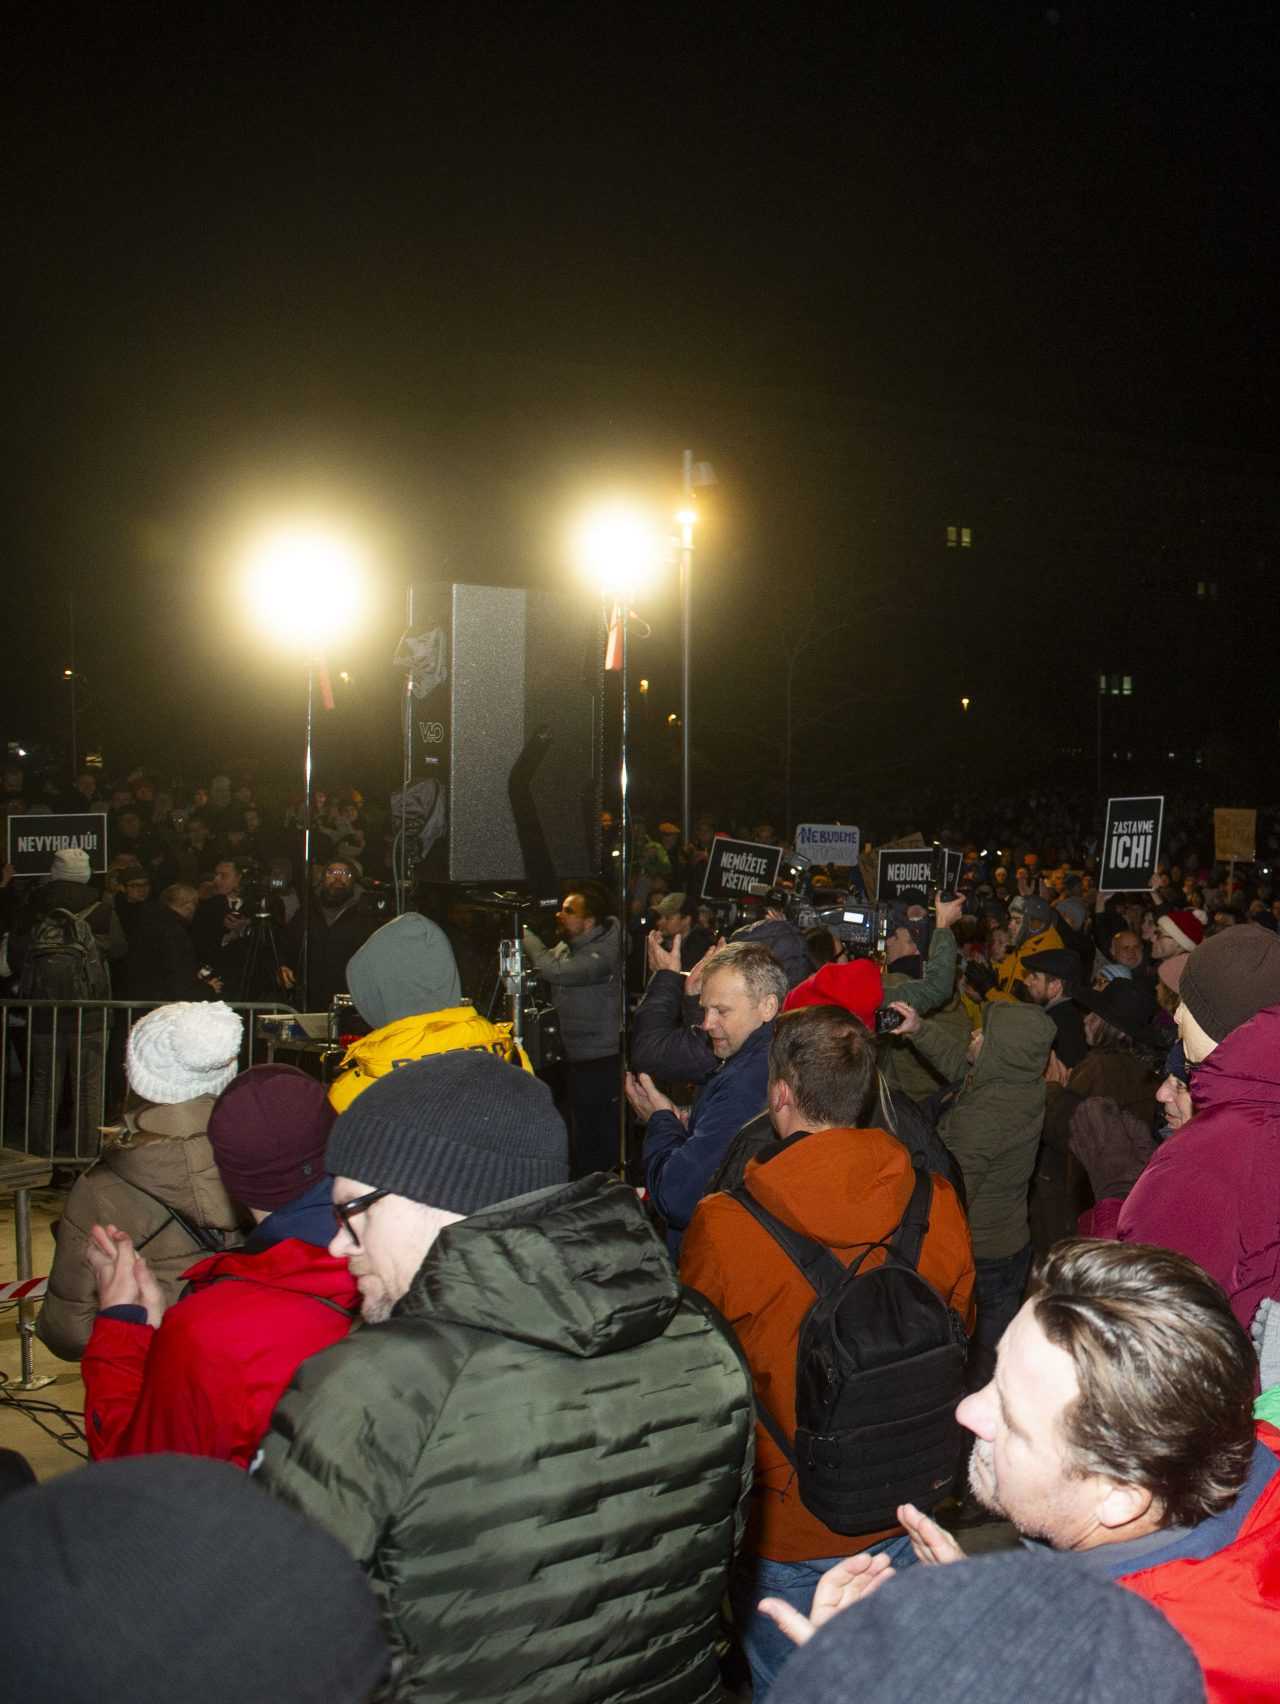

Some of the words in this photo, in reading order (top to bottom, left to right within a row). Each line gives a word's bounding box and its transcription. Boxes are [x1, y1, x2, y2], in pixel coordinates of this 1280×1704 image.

[800, 827, 857, 844] NEBUDEME
[1113, 820, 1154, 834] ZASTAVME
[17, 832, 97, 852] NEVYHRAJÚ!
[1109, 835, 1152, 869] ICH!
[720, 851, 768, 875] NEMÔŽETE
[887, 863, 935, 881] NEBUDEM
